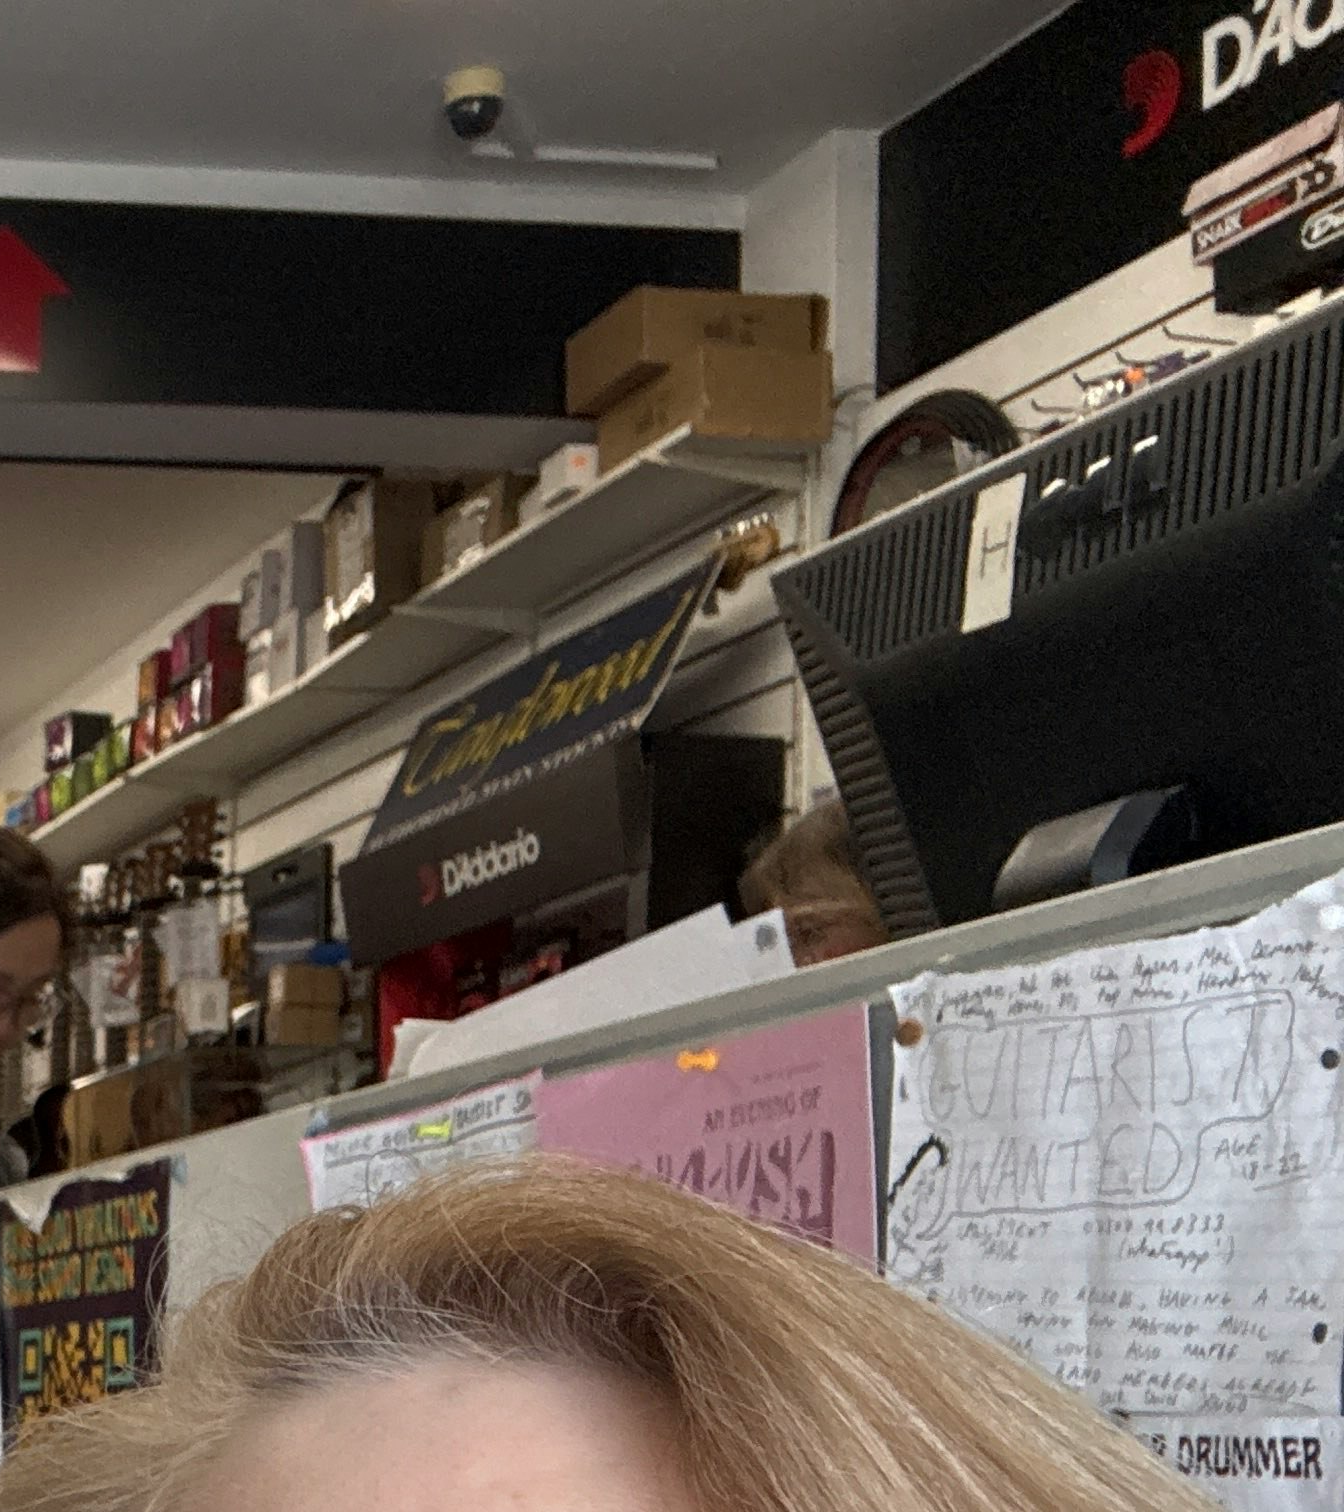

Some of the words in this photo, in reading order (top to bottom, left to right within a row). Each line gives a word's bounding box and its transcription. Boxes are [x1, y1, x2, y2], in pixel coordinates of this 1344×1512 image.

[442, 828, 541, 897] D'Addario
[926, 999, 1281, 1122] GUITARIST
[955, 1121, 1182, 1208] WANTED
[1214, 1133, 1262, 1160] AGE
[1250, 1287, 1268, 1306] A
[1177, 1434, 1324, 1481] DRUMMER
